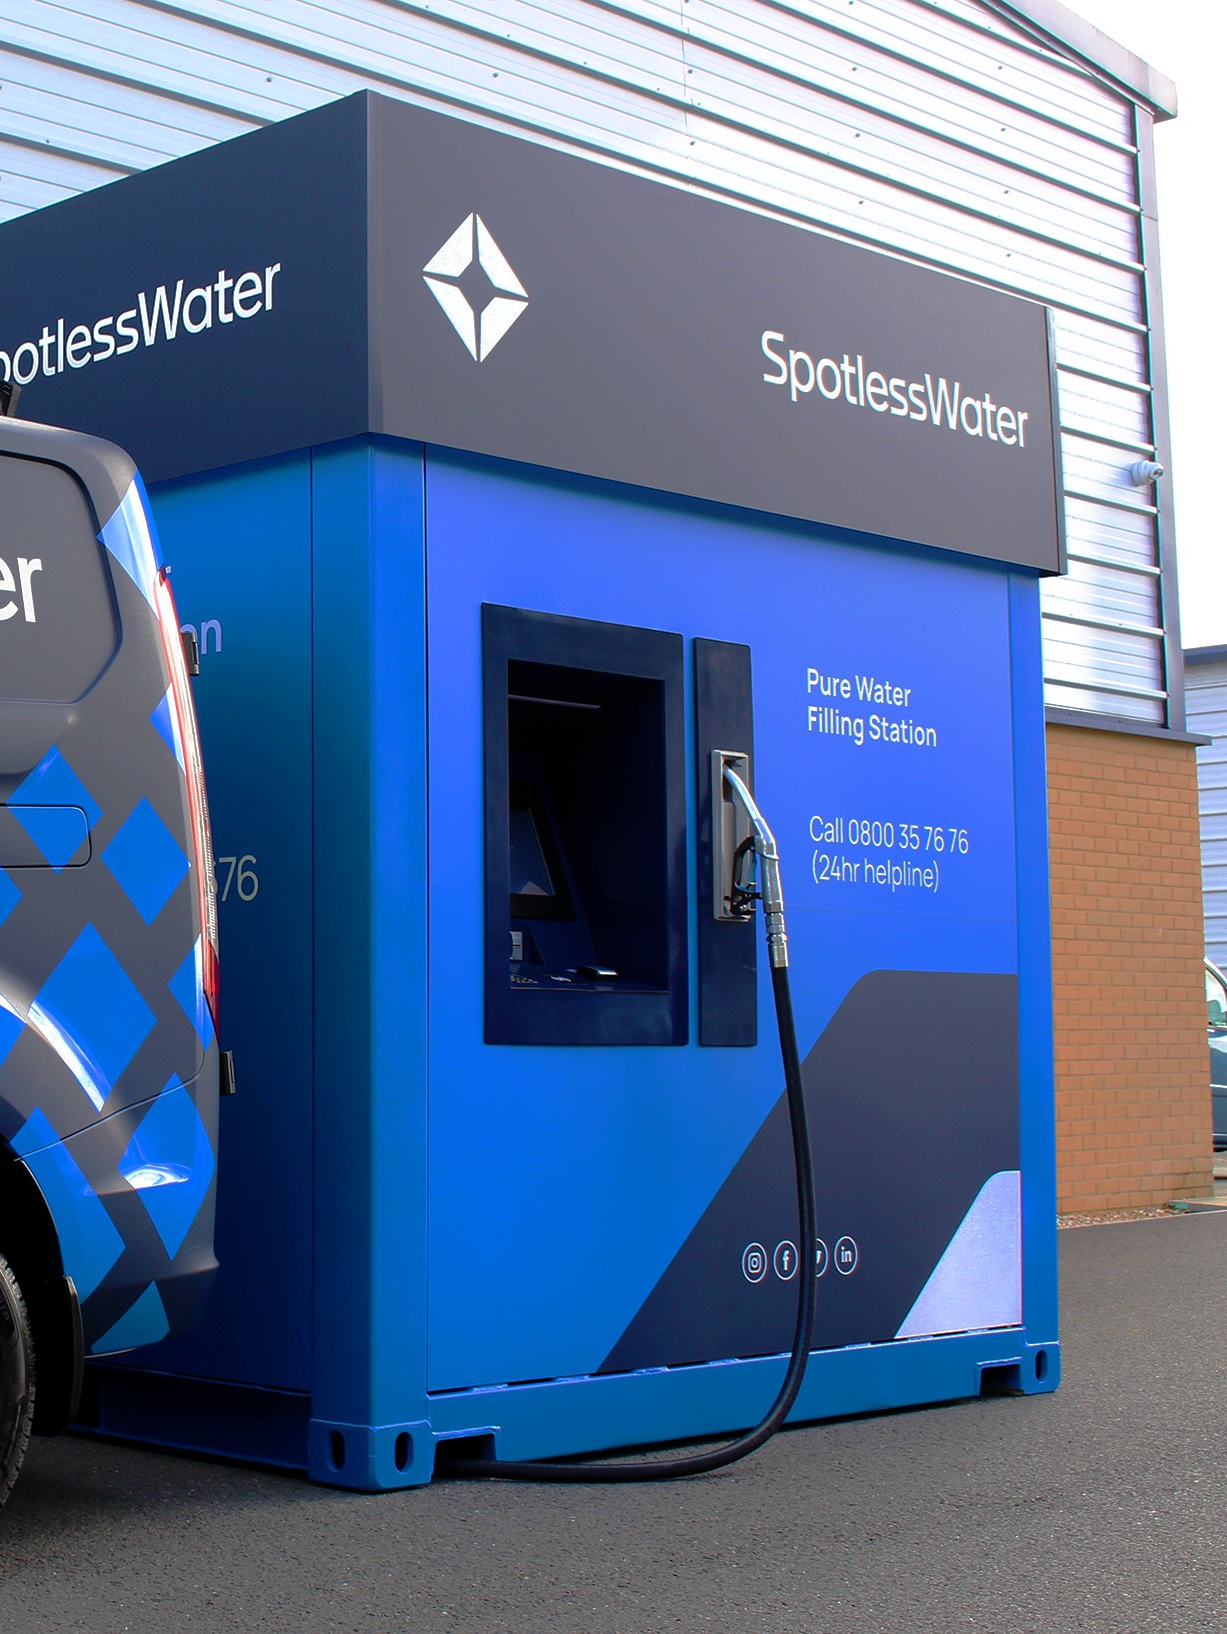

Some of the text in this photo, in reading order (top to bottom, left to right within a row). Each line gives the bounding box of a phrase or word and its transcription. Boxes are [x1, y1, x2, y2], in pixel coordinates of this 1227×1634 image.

[761, 330, 1028, 448] SpotlessWater
[807, 667, 911, 707] Pure Water
[808, 705, 937, 747] Filling Station
[809, 815, 969, 854] Call 0800 35 76 76
[214, 854, 259, 901] 76
[812, 849, 939, 893] (24hr helpline)
